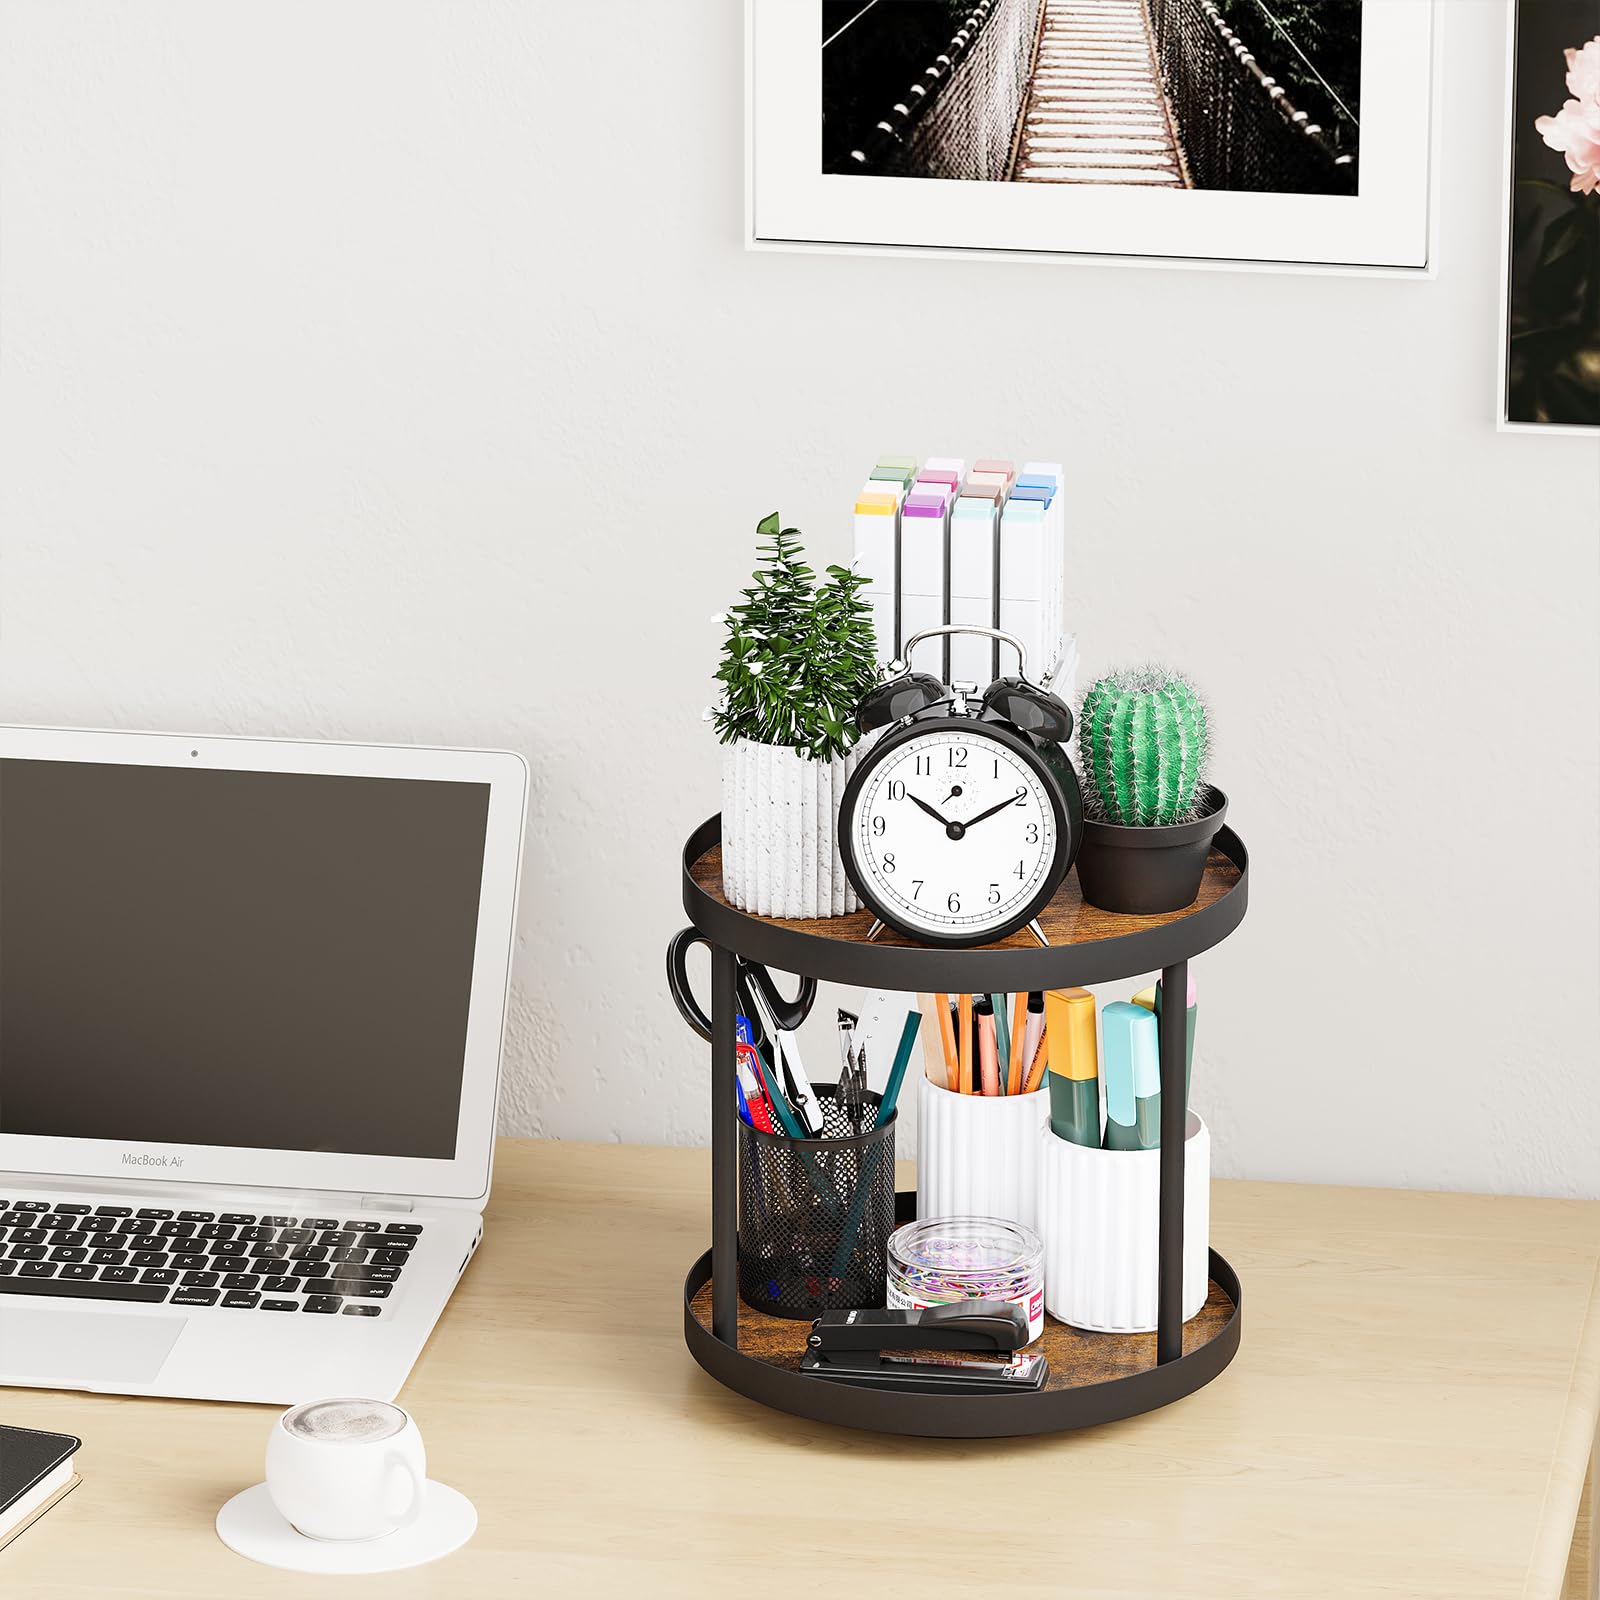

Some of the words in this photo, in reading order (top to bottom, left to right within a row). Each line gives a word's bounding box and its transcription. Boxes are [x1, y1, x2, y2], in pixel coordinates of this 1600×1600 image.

[915, 755, 931, 776] 11
[947, 747, 968, 768] 12
[993, 759, 999, 779] 1
[887, 780, 906, 801] 10
[1015, 786, 1028, 807] 2
[872, 815, 886, 837] 9
[1025, 823, 1039, 844] 3
[882, 853, 896, 873] 8
[1012, 860, 1026, 880] 4
[911, 880, 924, 901] 7
[987, 883, 1001, 904] 5
[947, 892, 961, 913] 6
[121, 1153, 168, 1167] MacBook
[169, 1156, 185, 1168] Air
